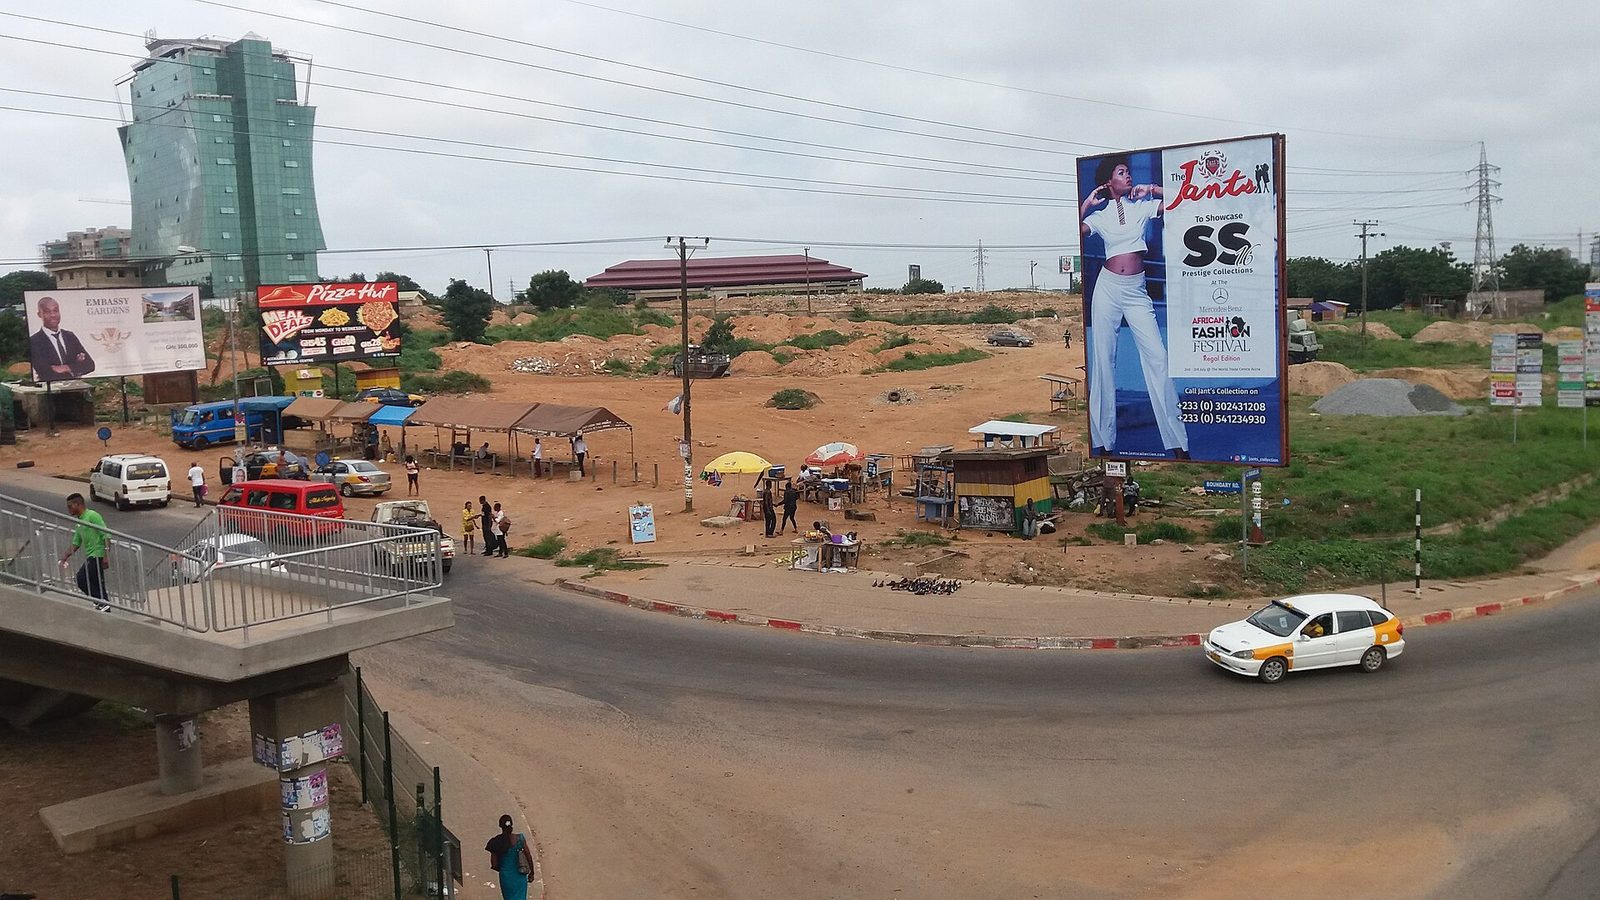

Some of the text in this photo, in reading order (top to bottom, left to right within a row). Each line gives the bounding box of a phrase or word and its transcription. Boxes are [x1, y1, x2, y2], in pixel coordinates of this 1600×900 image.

[1171, 173, 1185, 181] The
[1195, 212, 1244, 223] To Showcase
[1183, 222, 1252, 267] SS
[1182, 267, 1254, 278] Prestige Collections
[306, 284, 395, 303] Pizza Hut
[85, 297, 130, 307] EMBASSY
[86, 306, 130, 316] GARDENS
[262, 310, 304, 325] MEAL
[1192, 316, 1225, 325] AFRICAN
[267, 316, 313, 338] DEALS
[1192, 339, 1251, 353] FESTIVAL
[1203, 354, 1241, 363] Regal Edition
[1184, 387, 1197, 396] Call
[1197, 388, 1215, 397] Jant's
[1216, 388, 1249, 396] Collection
[1177, 400, 1266, 412] +233 (0) 302431208
[1177, 414, 1266, 425] +233 (0) 541234930
